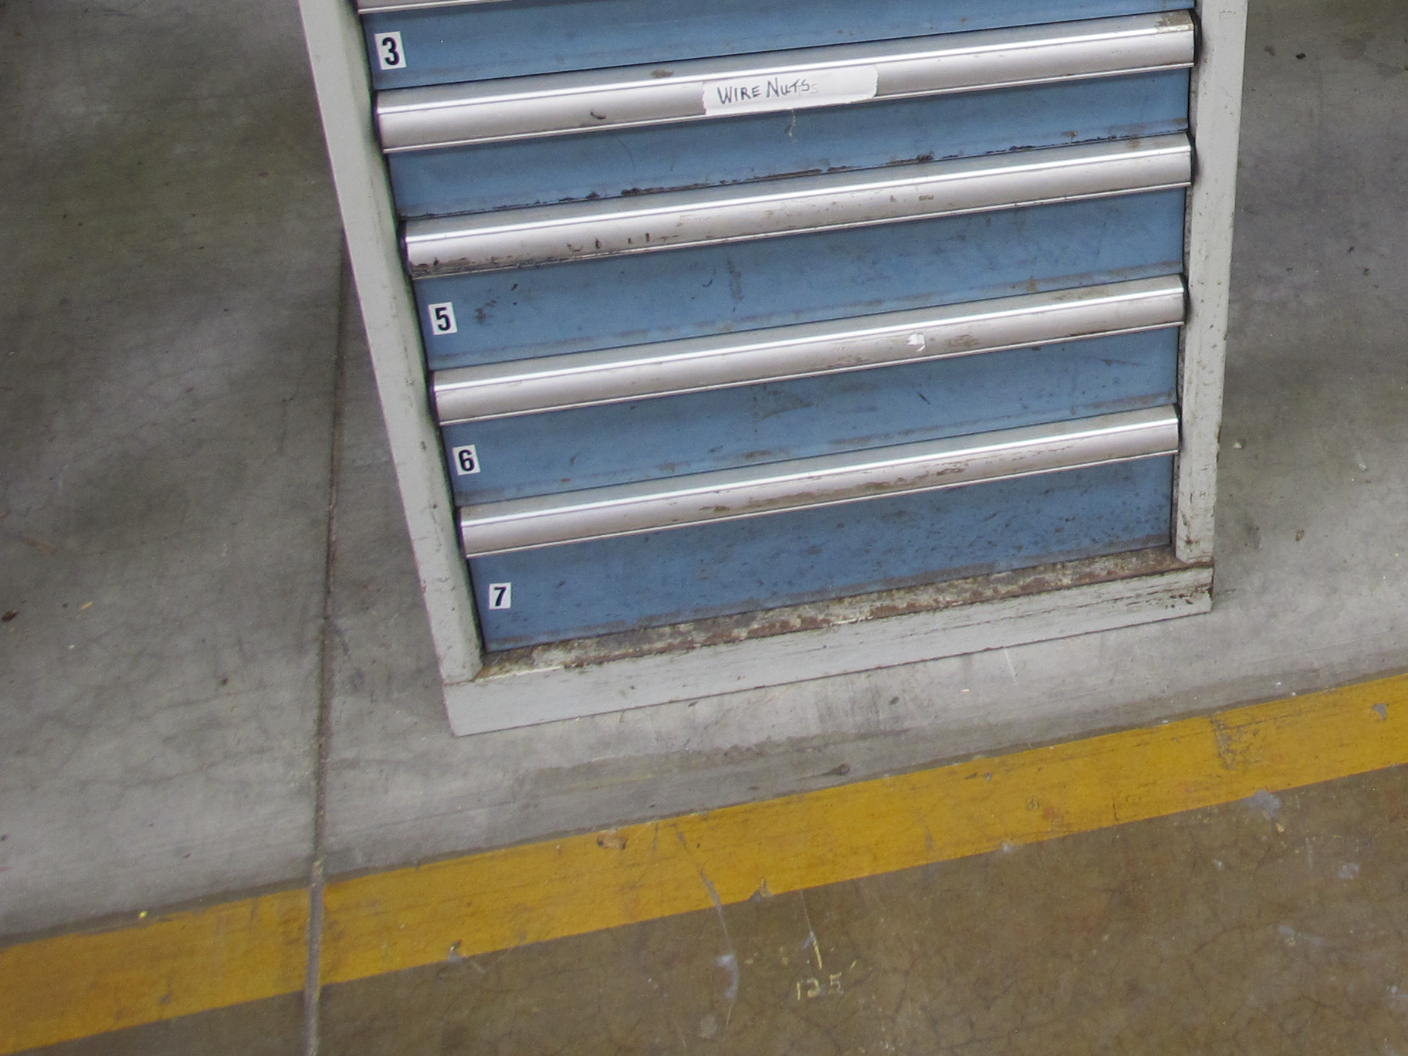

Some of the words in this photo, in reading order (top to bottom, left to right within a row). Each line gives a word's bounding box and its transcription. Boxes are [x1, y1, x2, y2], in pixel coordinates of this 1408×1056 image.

[381, 36, 400, 65] 3
[717, 84, 760, 105] WIRE
[434, 307, 451, 331] 5
[458, 449, 475, 472] 6
[493, 587, 507, 607] 7
